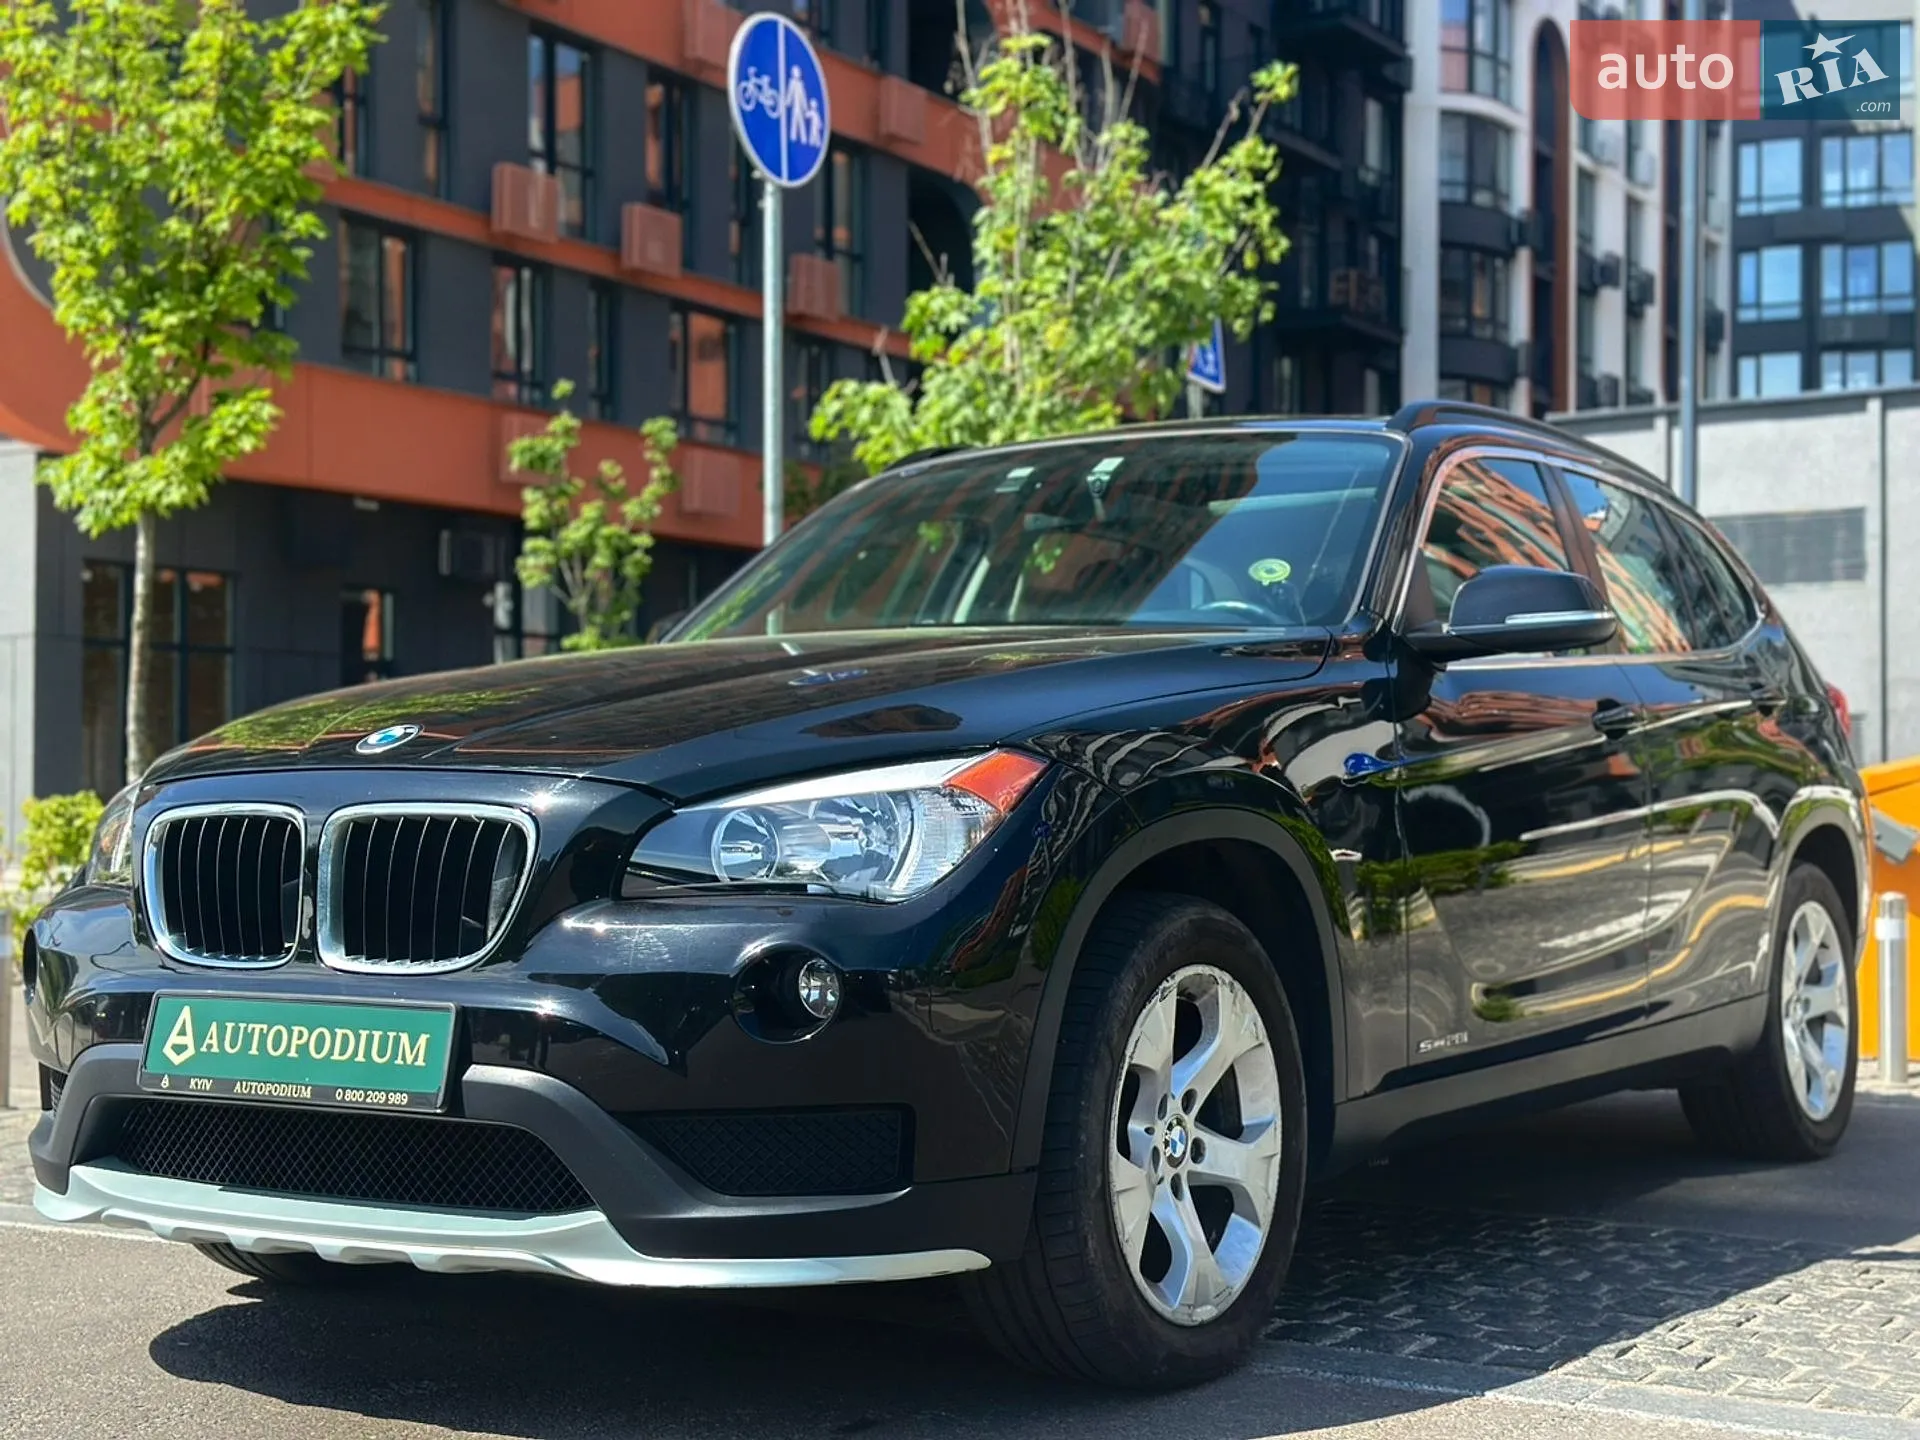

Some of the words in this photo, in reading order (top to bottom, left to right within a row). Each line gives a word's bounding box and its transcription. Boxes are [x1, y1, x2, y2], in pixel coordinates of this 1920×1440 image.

[200, 1021, 431, 1066] AUTOPODIUM
[189, 1077, 213, 1091] KYIV
[233, 1080, 312, 1099] AUTOPODIUM
[335, 1088, 343, 1101] 0
[344, 1089, 365, 1102] 800
[365, 1090, 386, 1103] 209
[387, 1092, 408, 1105] 989
